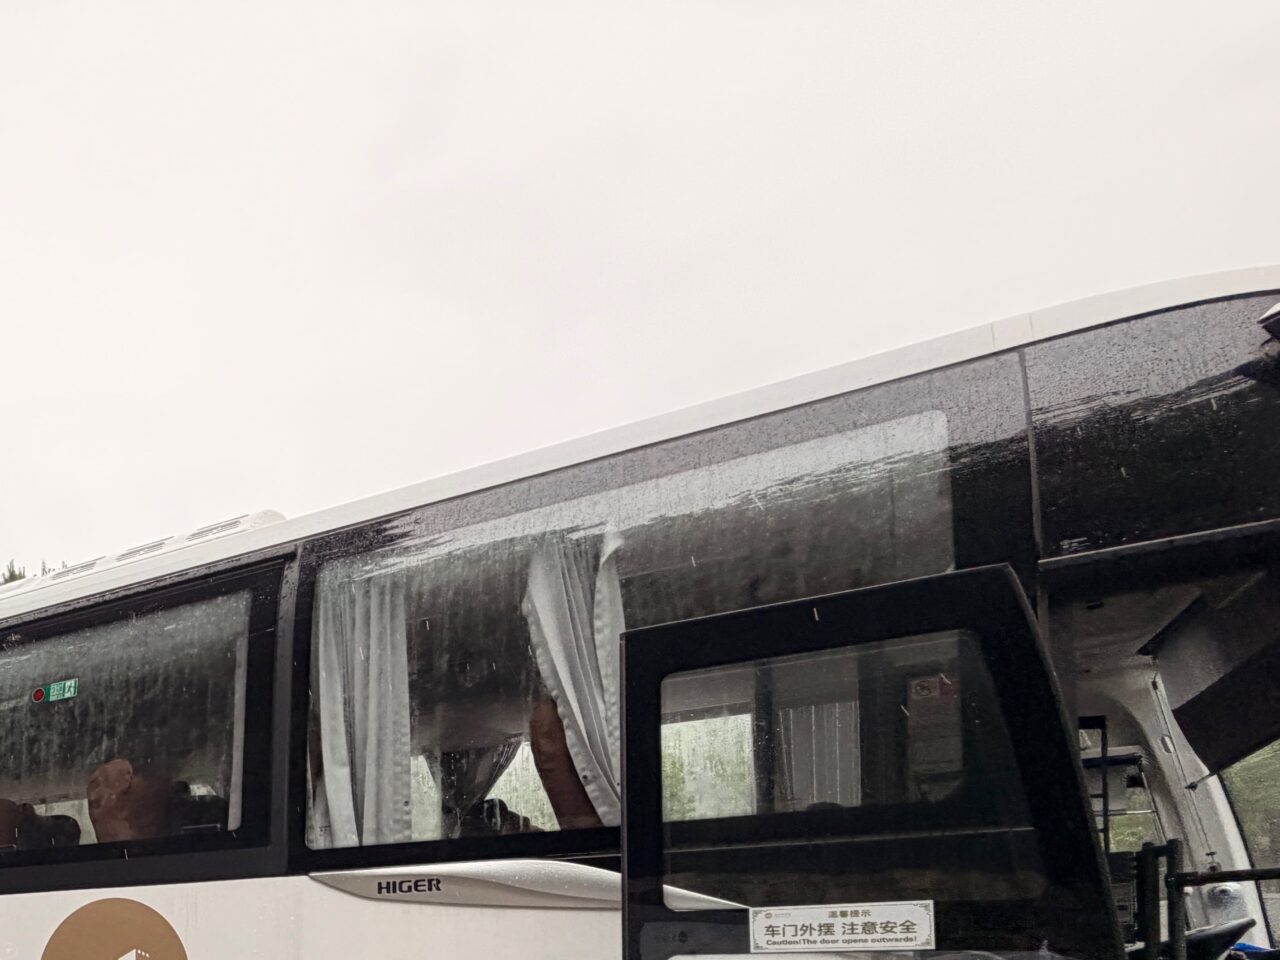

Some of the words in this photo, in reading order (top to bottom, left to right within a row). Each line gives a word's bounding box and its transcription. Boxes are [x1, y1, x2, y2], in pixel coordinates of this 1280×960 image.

[377, 877, 442, 895] HIGER
[764, 923, 835, 937] 车门外摆
[841, 920, 917, 935] 注意安全
